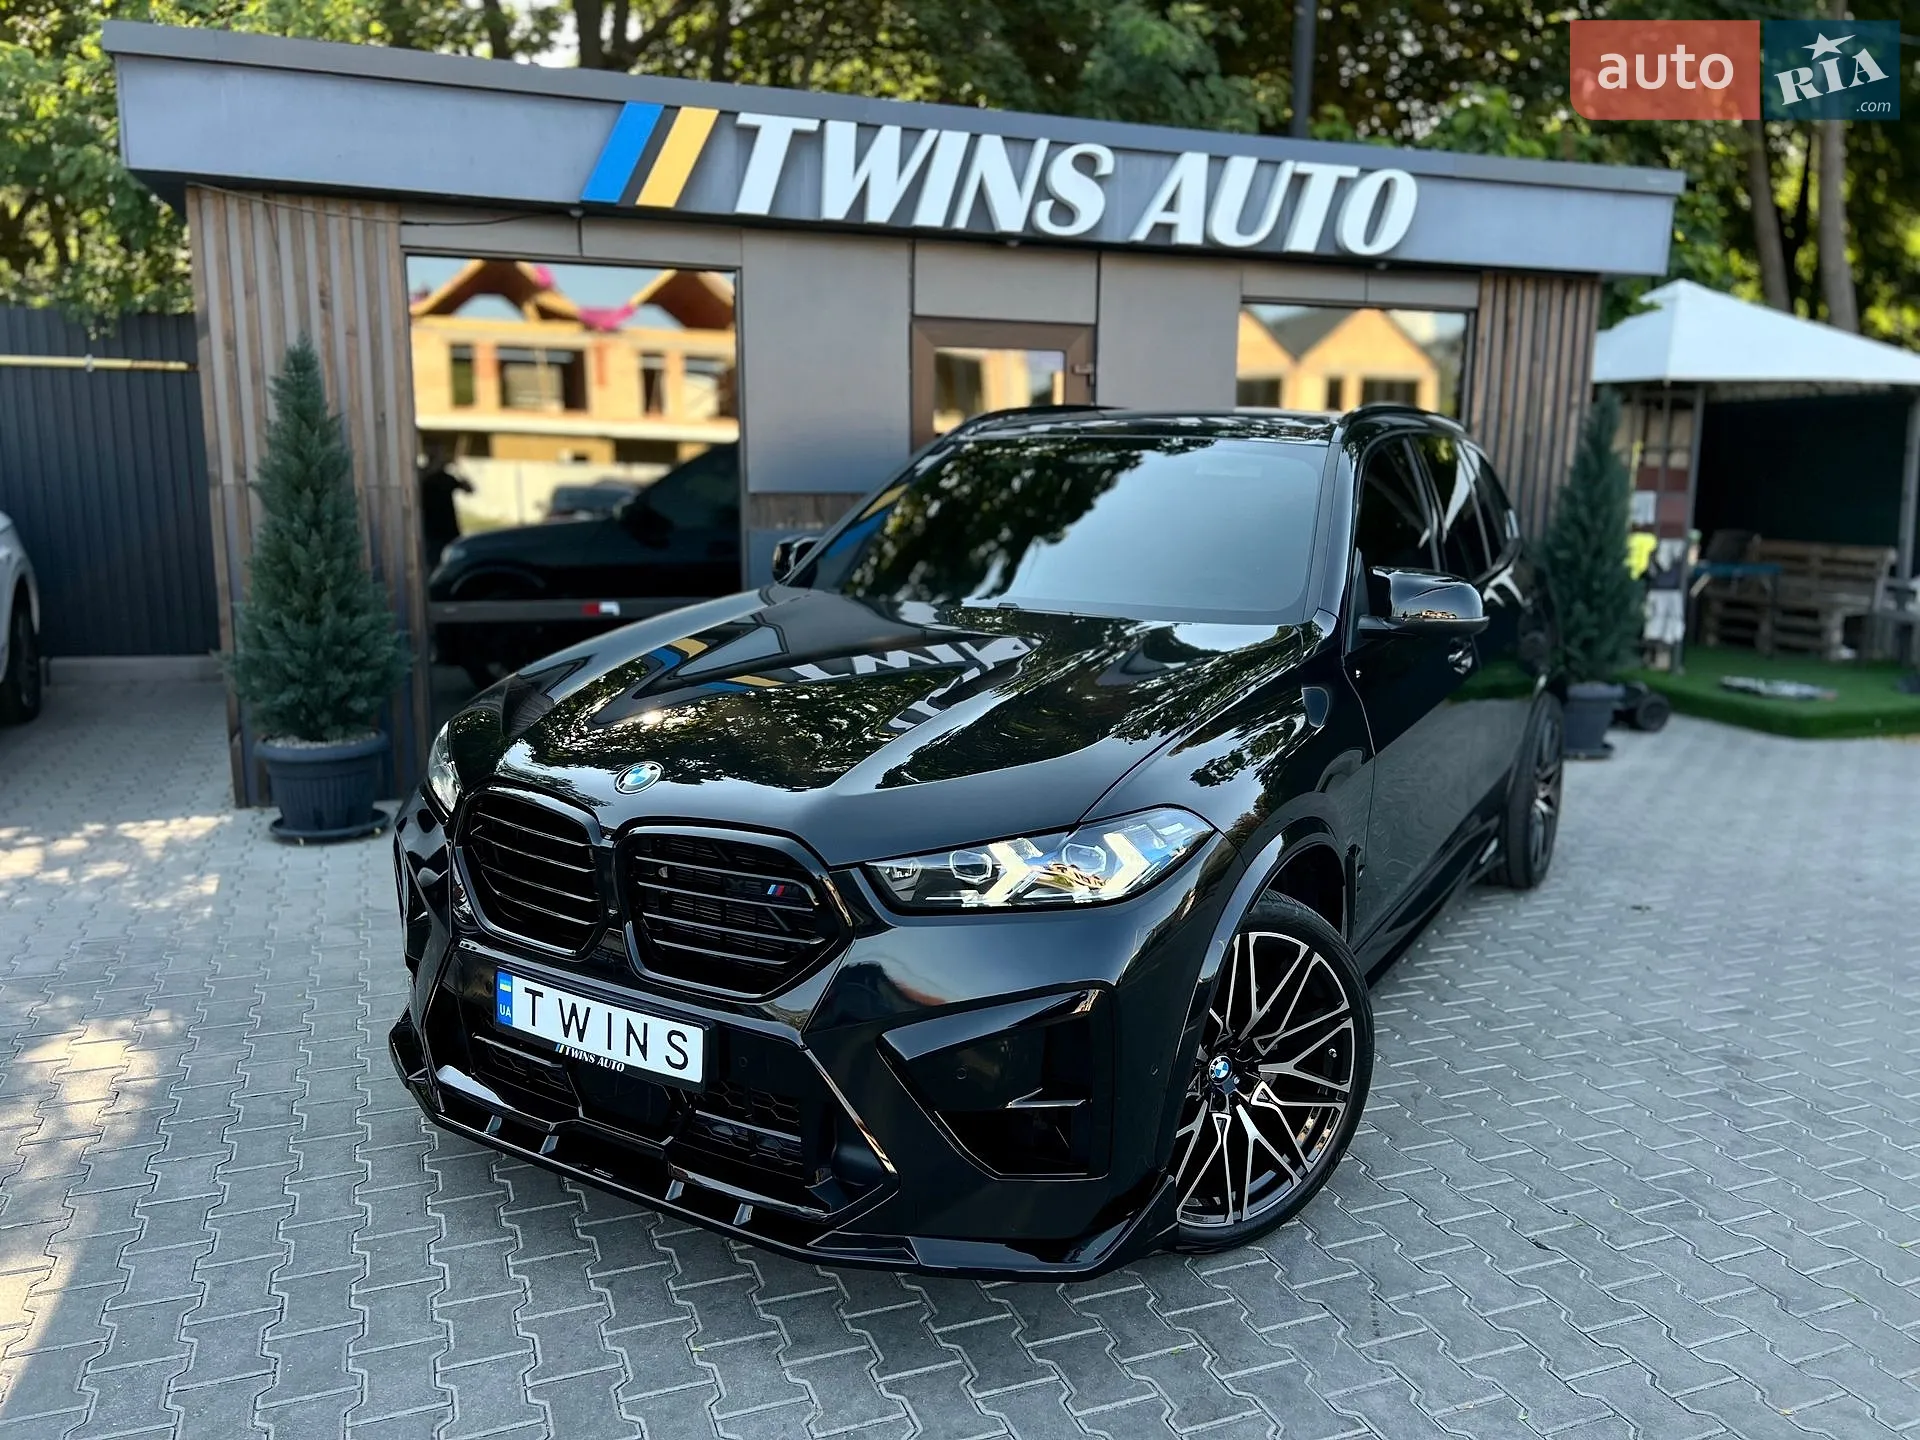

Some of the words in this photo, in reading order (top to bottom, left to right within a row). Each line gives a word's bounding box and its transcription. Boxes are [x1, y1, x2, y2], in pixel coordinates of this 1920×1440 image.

[733, 111, 1114, 237] TWINS
[1128, 152, 1419, 257] AUTO
[500, 1003, 512, 1018] UA
[524, 986, 689, 1071] TWINS
[565, 1045, 596, 1064] TWINS
[597, 1056, 625, 1073] AUTO
